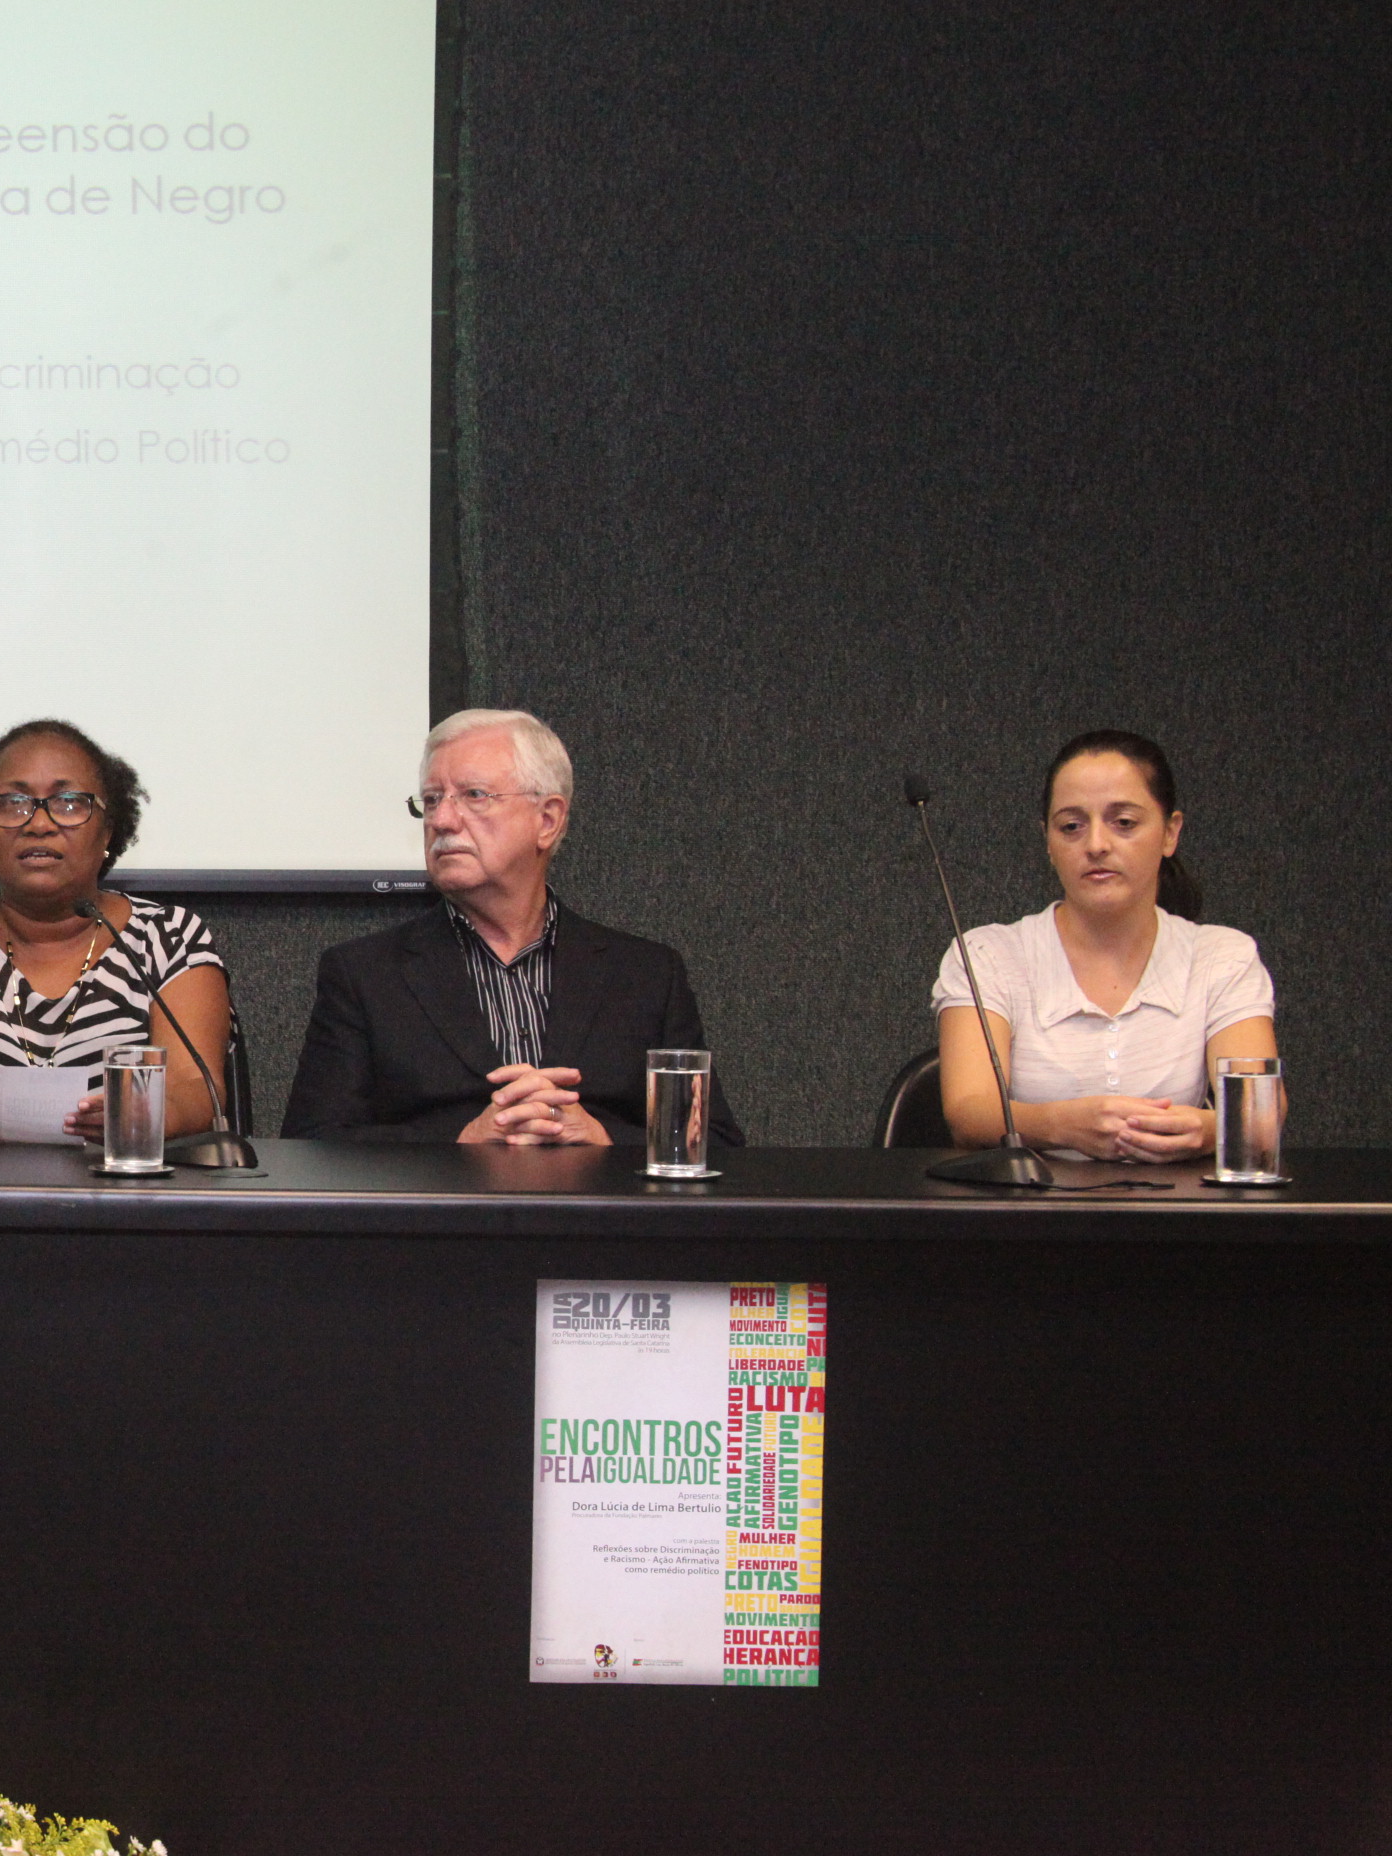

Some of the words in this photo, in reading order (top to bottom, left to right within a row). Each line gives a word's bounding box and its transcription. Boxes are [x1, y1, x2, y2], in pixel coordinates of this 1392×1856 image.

[183, 111, 251, 152] do
[44, 175, 112, 216] de
[131, 176, 287, 226] Negro
[138, 429, 289, 465] Político
[571, 1292, 671, 1319] 20/03
[730, 1287, 776, 1307] PRETO
[553, 1292, 572, 1329] DIA
[571, 1318, 670, 1331] QUINTA-FEIRA
[729, 1320, 787, 1333] MOVIMENTO
[728, 1358, 806, 1371] LIBERDADE
[728, 1371, 809, 1387] RACISMO
[747, 1385, 826, 1413] LUTA
[540, 1418, 723, 1457] ENCONTROS
[727, 1387, 743, 1474] FUTURO
[539, 1456, 722, 1485] PELAIGUALDADE
[744, 1412, 762, 1529] AFIRMATIVA
[677, 1492, 722, 1501] Apresenta:
[572, 1501, 598, 1512] Dora
[601, 1501, 629, 1512] Lúcia
[631, 1502, 646, 1512] de
[648, 1502, 675, 1513] Lima
[677, 1503, 722, 1513] Bertulio
[739, 1532, 796, 1545] MULHER
[593, 1545, 633, 1553] Reflexões
[634, 1545, 659, 1553] sobre
[660, 1545, 720, 1556] Discriminação
[611, 1555, 646, 1563] Racismo
[652, 1556, 674, 1565] Ação
[676, 1556, 720, 1565] Afirmativa
[738, 1545, 796, 1558] HOMEM
[650, 1565, 686, 1574] remédio
[688, 1566, 720, 1576] político
[725, 1570, 798, 1591] COTAS
[725, 1593, 779, 1613] PRETO
[779, 1594, 821, 1605] PARDO
[724, 1612, 820, 1627] MOVIMENTO
[724, 1628, 820, 1648] EDUCAÇÃO
[724, 1647, 820, 1668] HERANÇA
